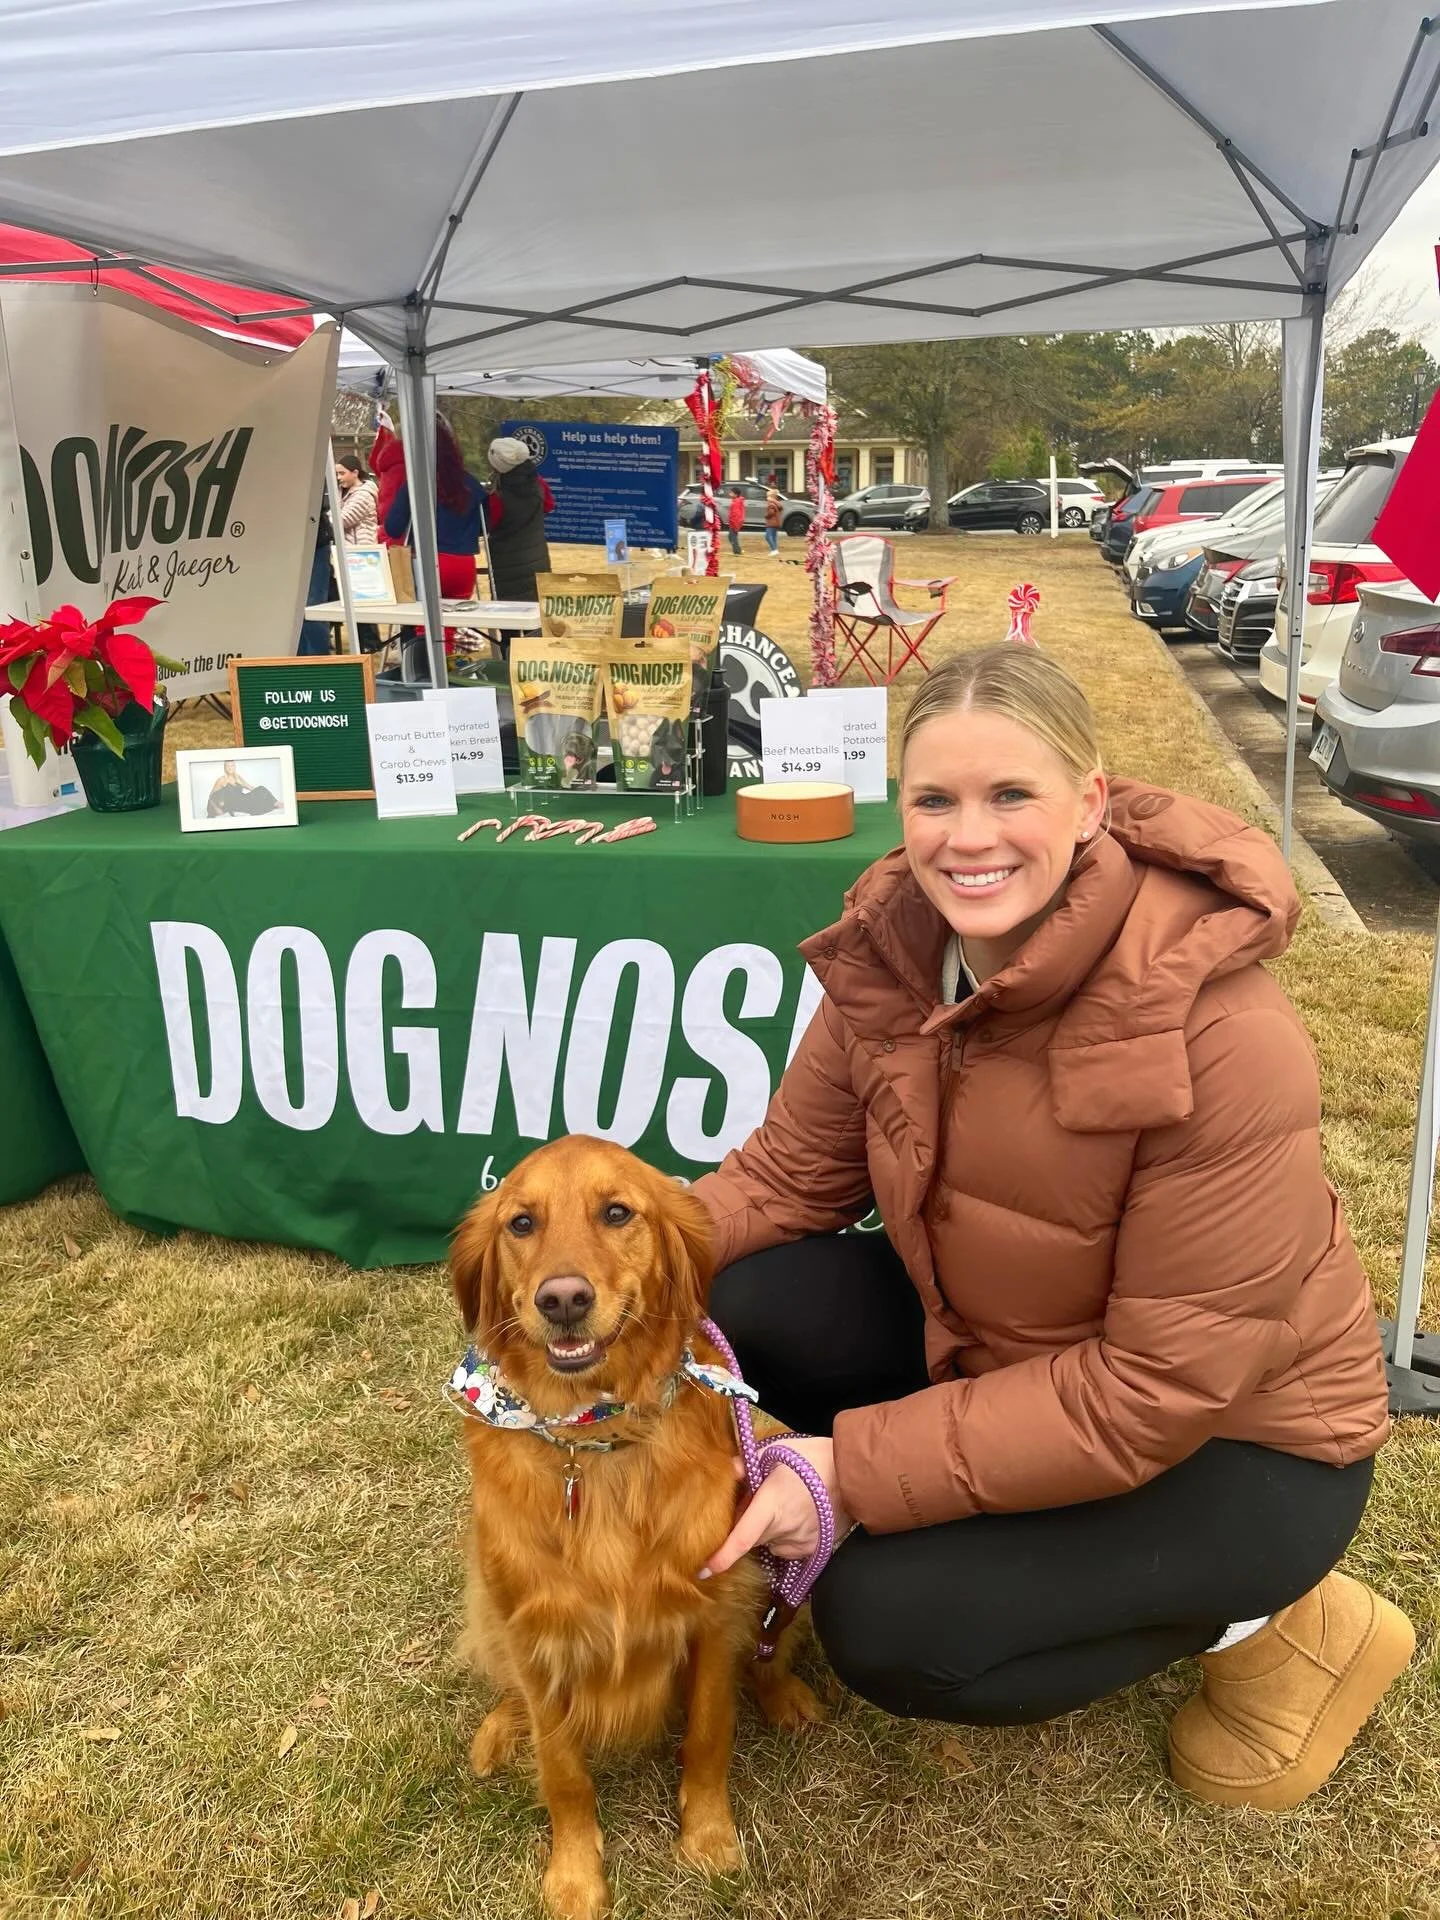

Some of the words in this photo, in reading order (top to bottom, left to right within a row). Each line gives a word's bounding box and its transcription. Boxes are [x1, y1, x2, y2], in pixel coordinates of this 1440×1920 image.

[562, 432, 587, 445] Help
[589, 434, 602, 443] us
[604, 433, 628, 446] help
[630, 434, 661, 445] them!
[111, 555, 145, 601] Kat
[147, 555, 160, 583] &
[163, 550, 241, 598] Jaeger
[194, 655, 213, 673] the
[264, 690, 312, 704] FOLLOW
[320, 689, 336, 702] US
[259, 714, 348, 730] @GETDOGNOSH
[374, 733, 411, 742] Peanut
[414, 731, 446, 740] Butter
[470, 735, 499, 745] Breast
[843, 736, 886, 745] Potatoes
[408, 745, 415, 753] &
[763, 746, 787, 756] Beef
[789, 745, 840, 756] Meatballs
[380, 760, 411, 769] Carob
[413, 758, 447, 767] Chews
[781, 762, 821, 773] $14.99
[396, 772, 433, 784] $13.99
[771, 813, 800, 821] NOSH
